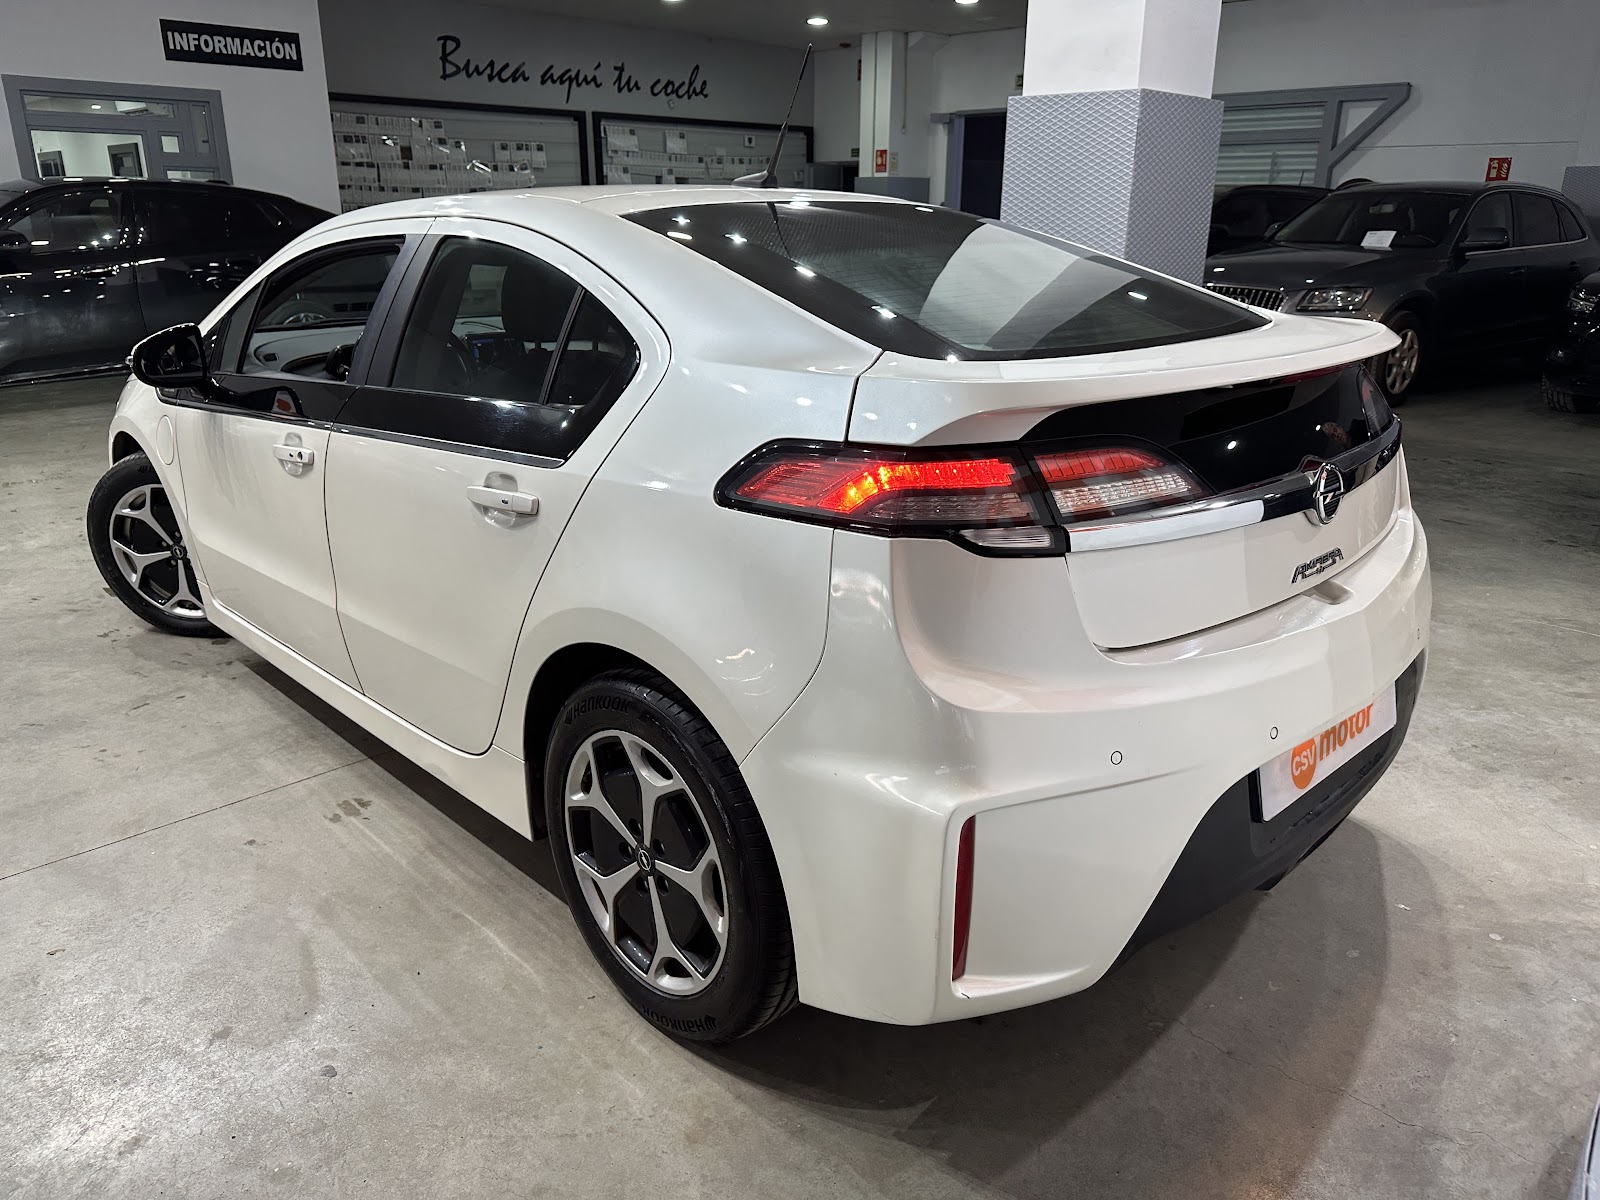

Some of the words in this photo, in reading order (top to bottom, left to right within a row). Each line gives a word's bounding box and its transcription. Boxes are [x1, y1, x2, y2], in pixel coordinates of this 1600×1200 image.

[166, 31, 298, 61] INFORMACIÓN
[437, 34, 530, 81] Busca
[540, 62, 603, 104] aquí
[613, 62, 642, 93] tu
[650, 64, 709, 100] coche
[1319, 702, 1373, 762] motor
